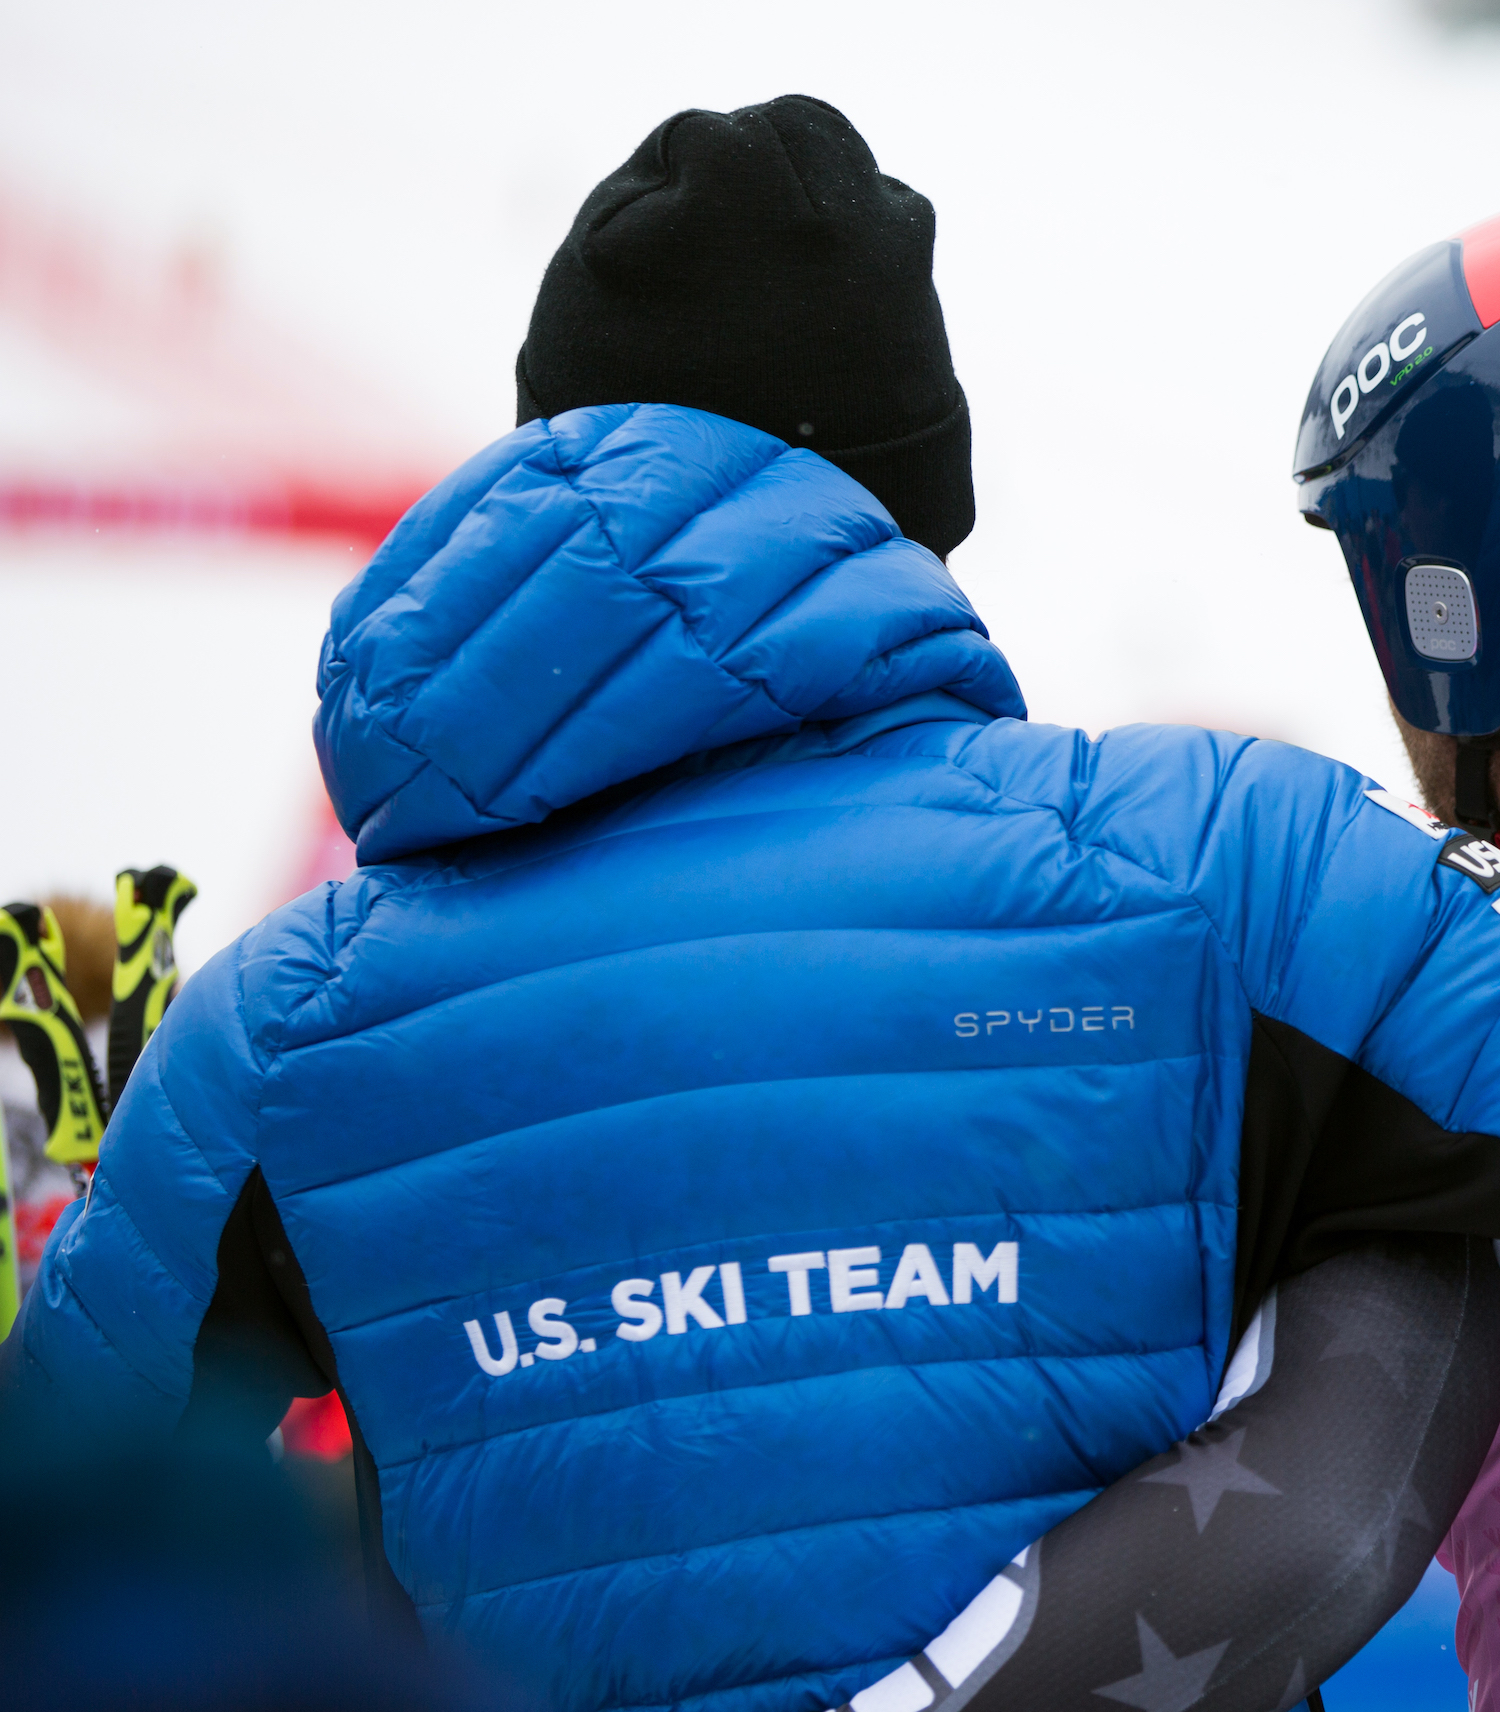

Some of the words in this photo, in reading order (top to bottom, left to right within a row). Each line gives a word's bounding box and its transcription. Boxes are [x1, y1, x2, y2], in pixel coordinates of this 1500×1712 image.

[954, 1005, 1135, 1038] SPYDER
[63, 1058, 93, 1142] LEKI
[463, 1297, 597, 1377] U.S.
[611, 1261, 747, 1342] SKI
[767, 1241, 1019, 1317] TEAM
